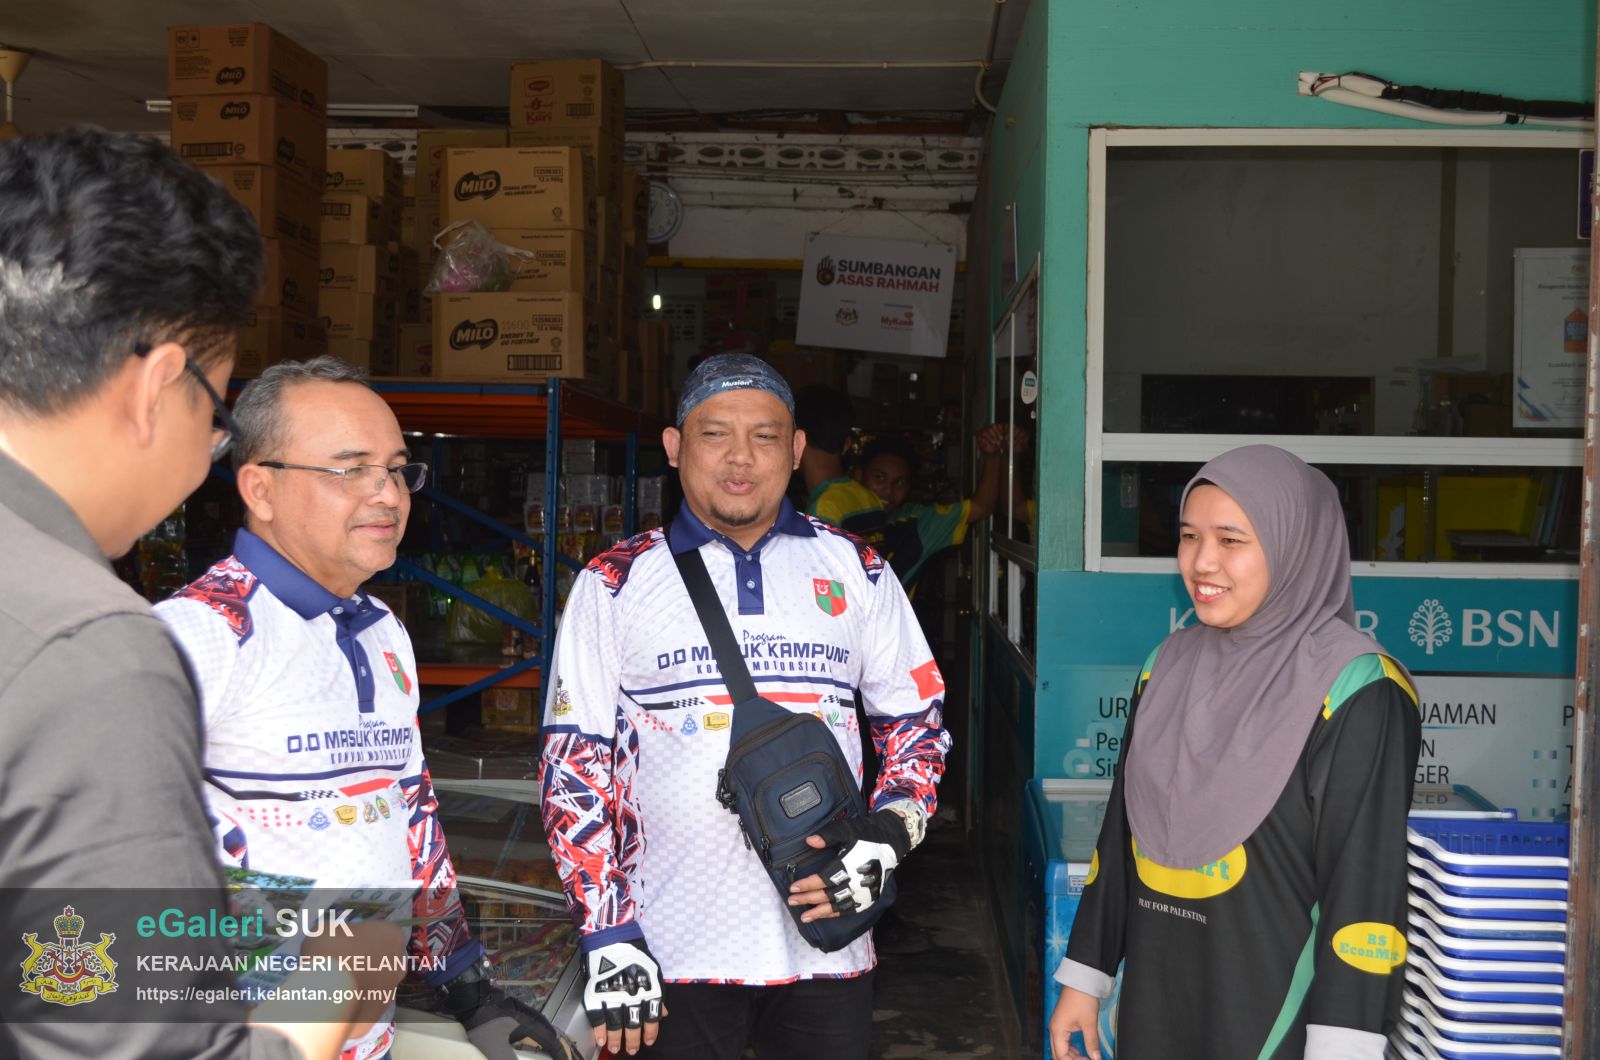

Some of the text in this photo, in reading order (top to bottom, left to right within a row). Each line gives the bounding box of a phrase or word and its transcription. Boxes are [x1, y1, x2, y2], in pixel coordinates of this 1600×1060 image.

[220, 71, 242, 81] MILO
[225, 105, 247, 114] MILO
[460, 178, 497, 194] MILO
[838, 260, 941, 280] SUMBANGAN
[836, 274, 939, 292] ASAS RAHMAH
[455, 326, 495, 343] MILO
[1462, 609, 1560, 648] BSN
[743, 630, 786, 645] Program
[753, 660, 831, 673] MOTORSIKA
[1420, 702, 1497, 725] JAMAN
[324, 729, 372, 749] MASUK
[1152, 901, 1169, 913] FOR
[1170, 906, 1207, 925] PALESTINE
